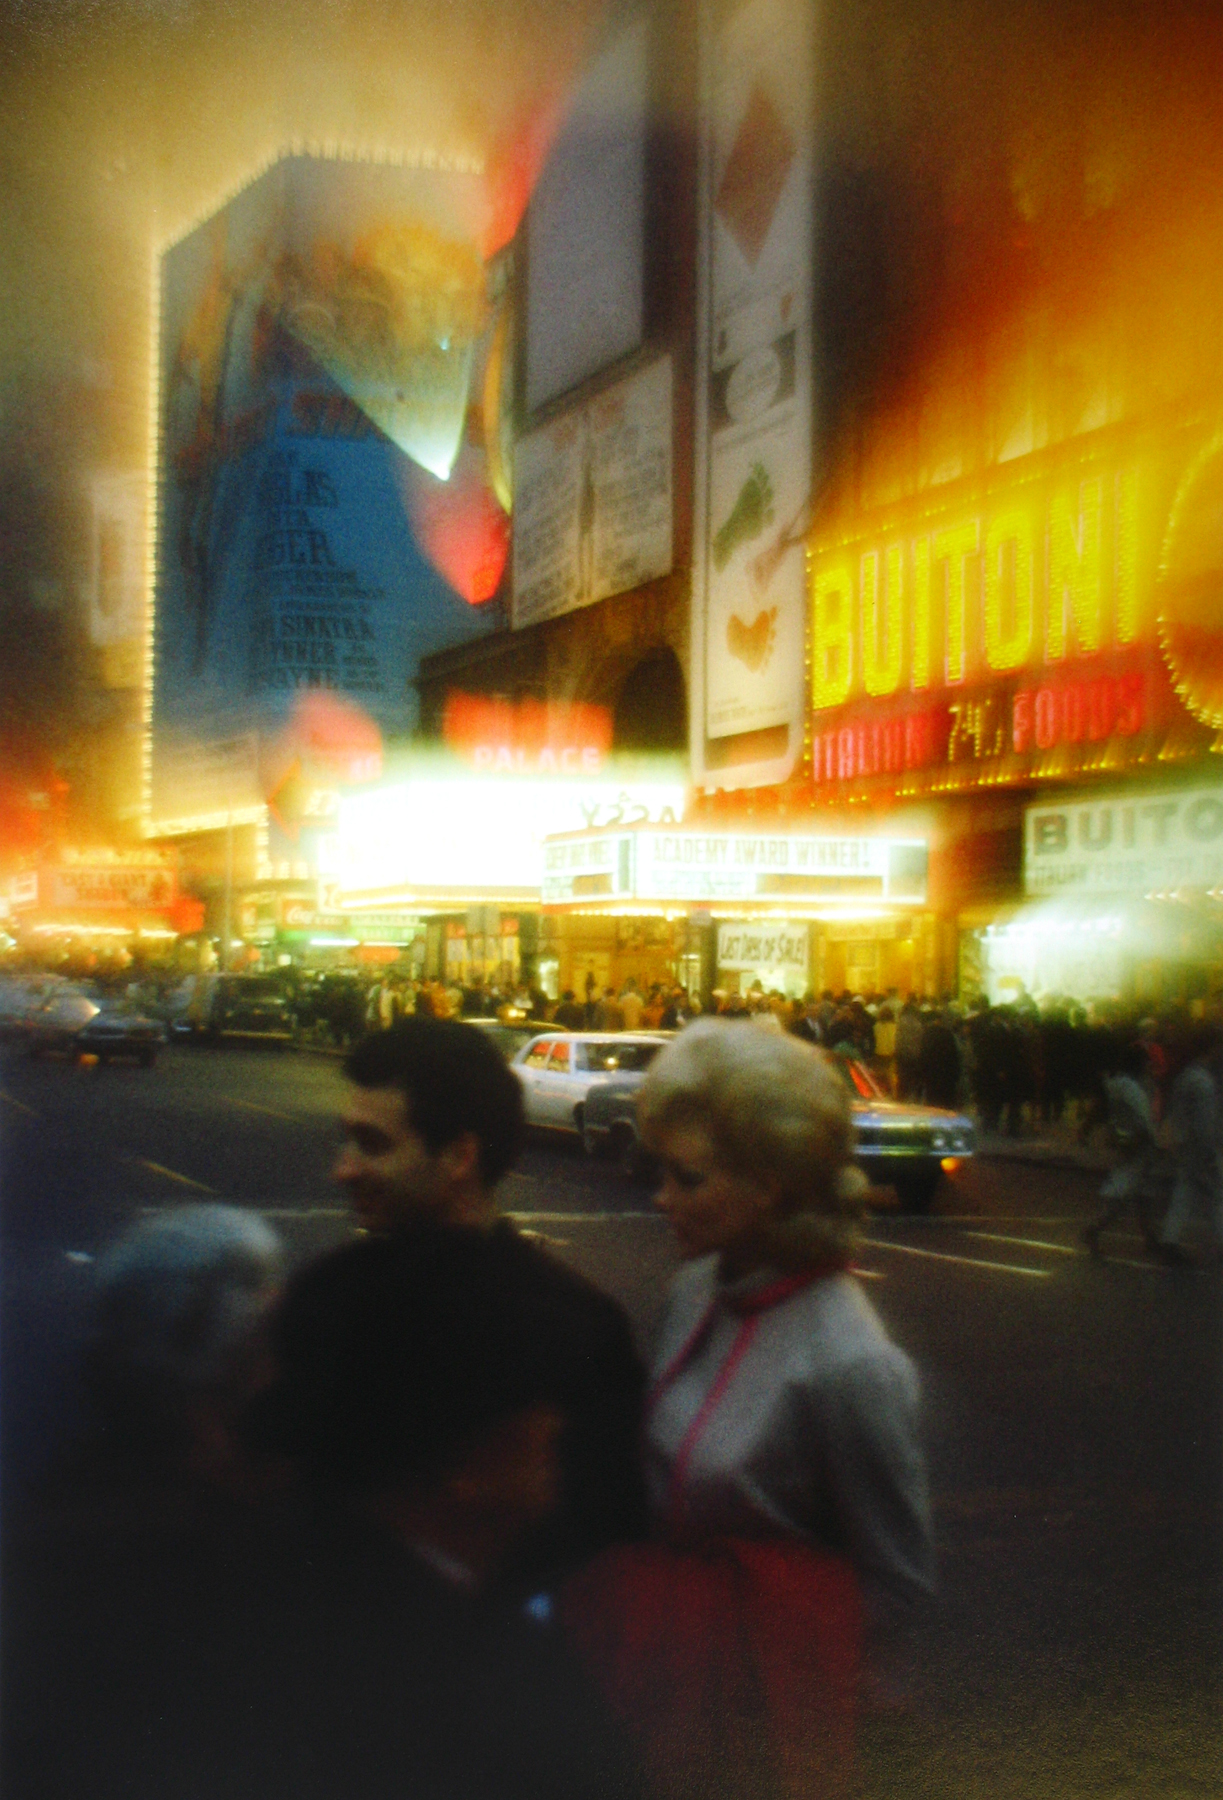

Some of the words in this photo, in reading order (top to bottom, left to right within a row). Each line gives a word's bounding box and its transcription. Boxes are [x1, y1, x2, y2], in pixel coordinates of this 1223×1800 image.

[812, 471, 1138, 714] BUITONI
[1013, 673, 1141, 753] FOODS
[473, 746, 600, 775] PALACE
[652, 836, 730, 865] ACADEMY
[734, 838, 789, 867] AWARD
[1034, 798, 1223, 855] BUITO
